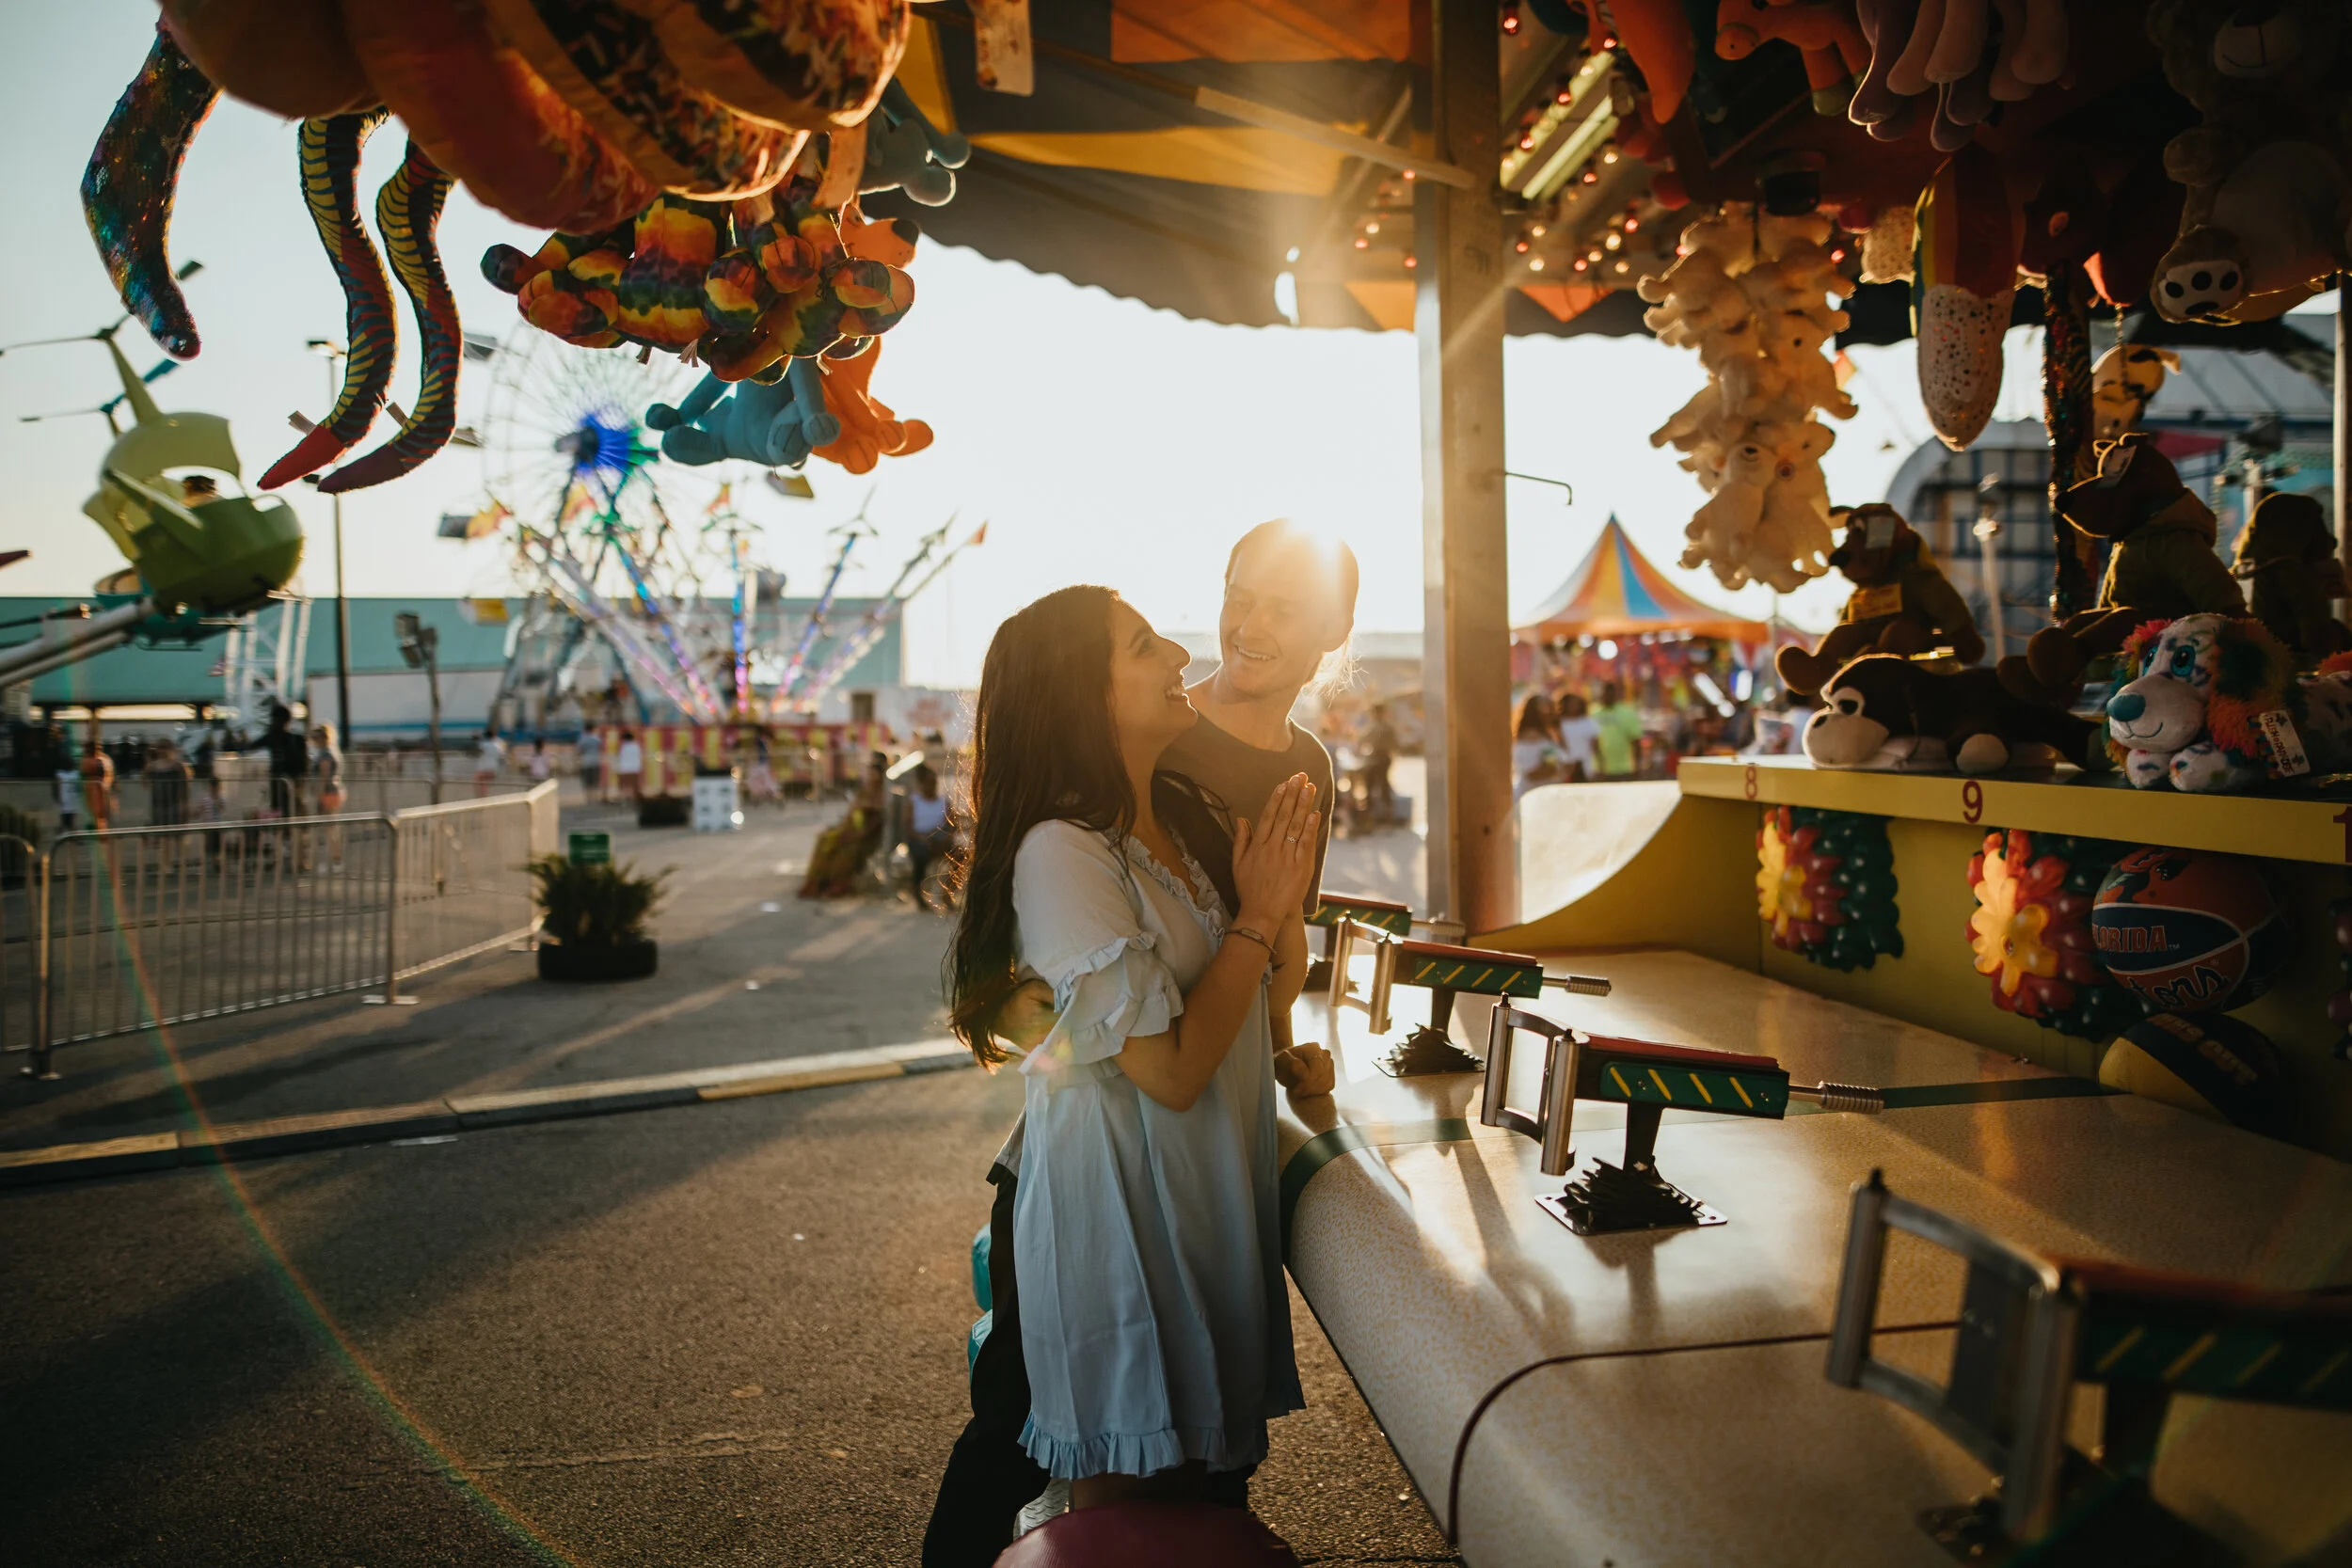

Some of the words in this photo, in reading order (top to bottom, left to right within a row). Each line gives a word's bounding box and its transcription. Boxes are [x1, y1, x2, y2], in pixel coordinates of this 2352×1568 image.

[1745, 766, 1757, 800] 8
[1963, 780, 1982, 823] 9
[2091, 923, 2168, 953] LORIDA
